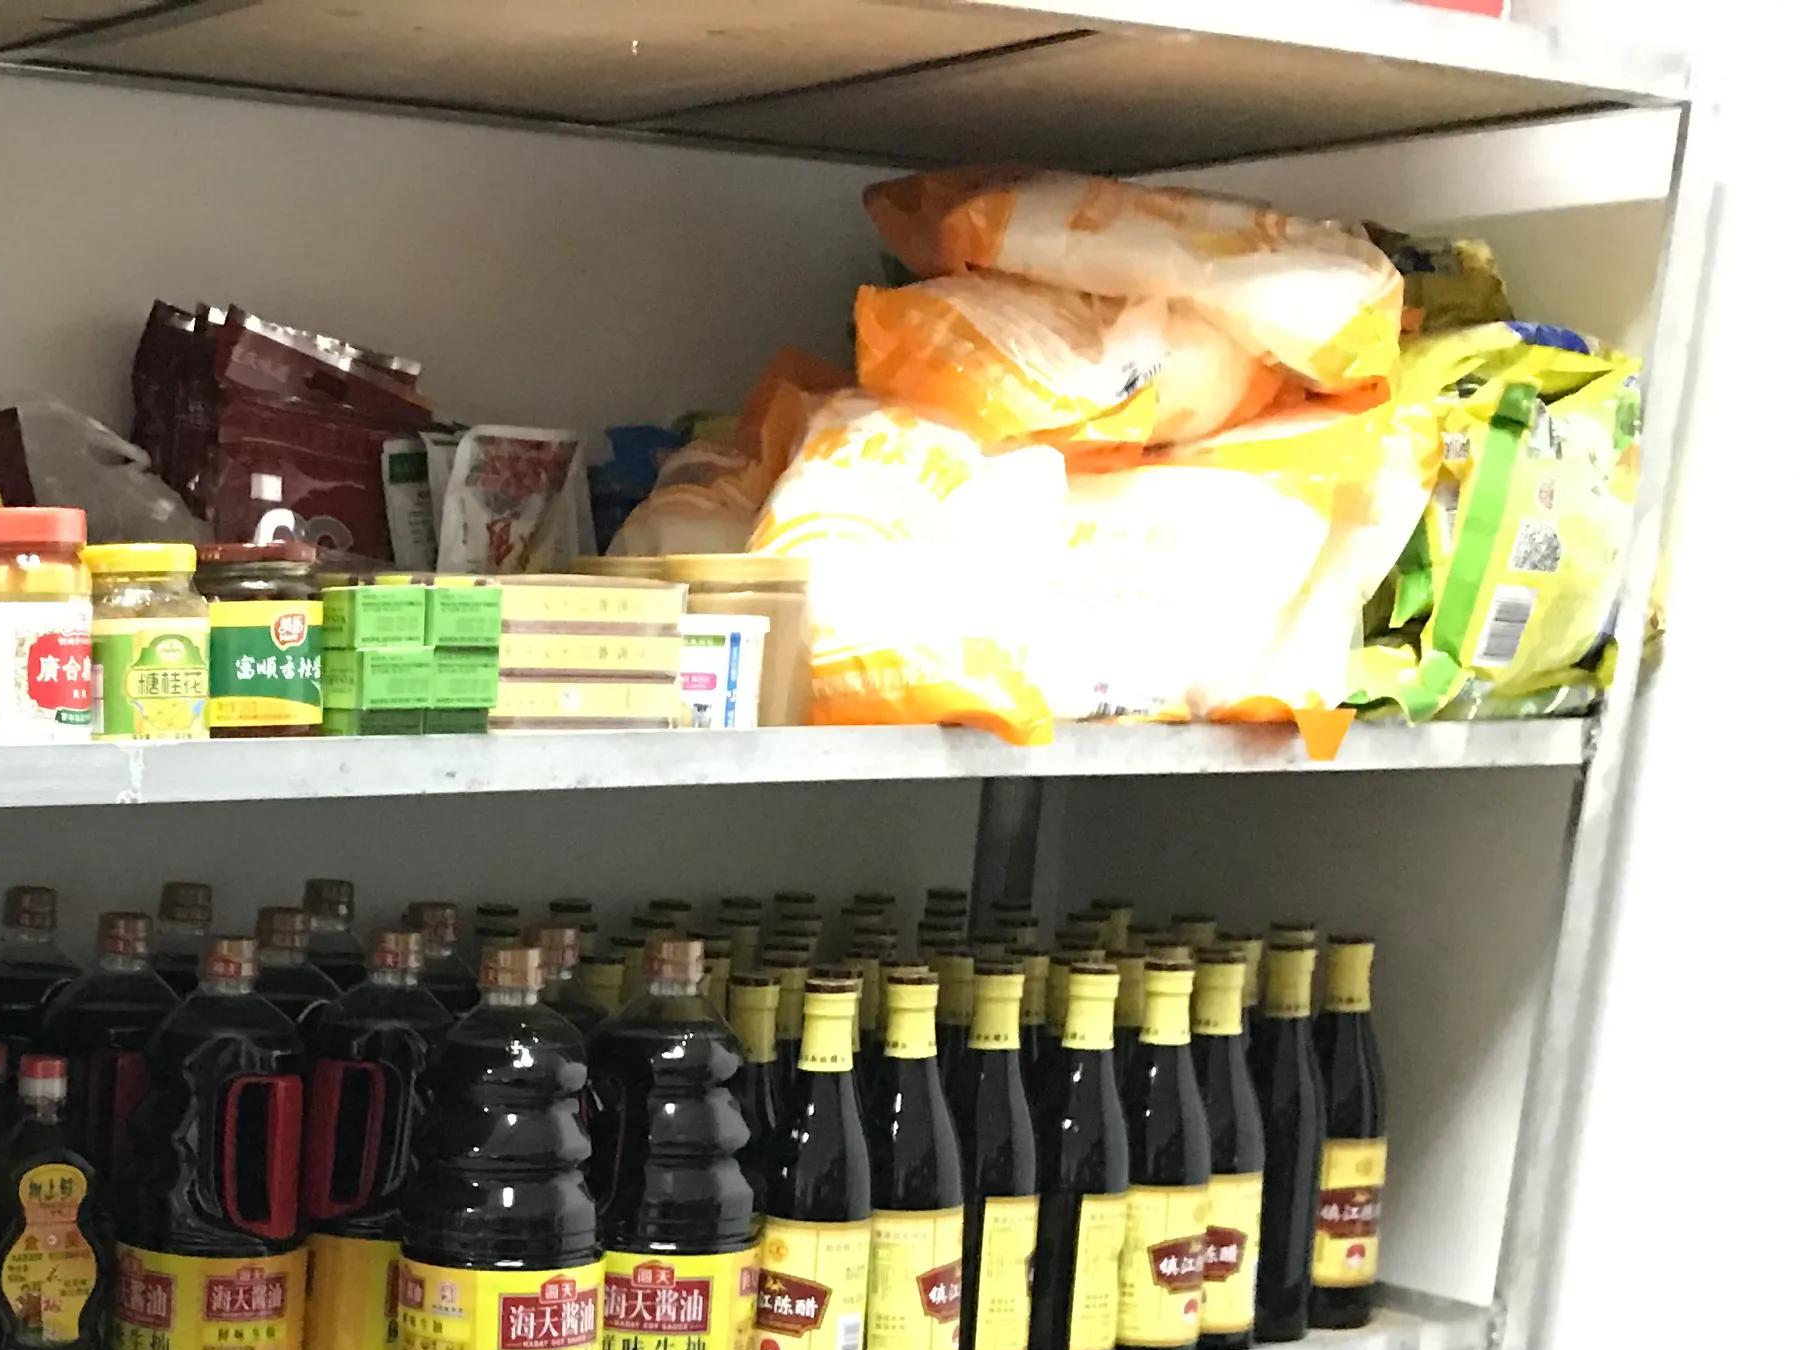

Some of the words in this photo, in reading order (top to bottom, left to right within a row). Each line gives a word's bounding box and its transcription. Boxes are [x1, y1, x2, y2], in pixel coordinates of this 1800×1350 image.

[544, 1282, 575, 1301] 海天
[637, 1268, 672, 1285] 海天
[210, 1282, 284, 1313] 海天酱油
[604, 1284, 704, 1323] 海天酱油
[509, 1298, 596, 1341] 海天酱油
